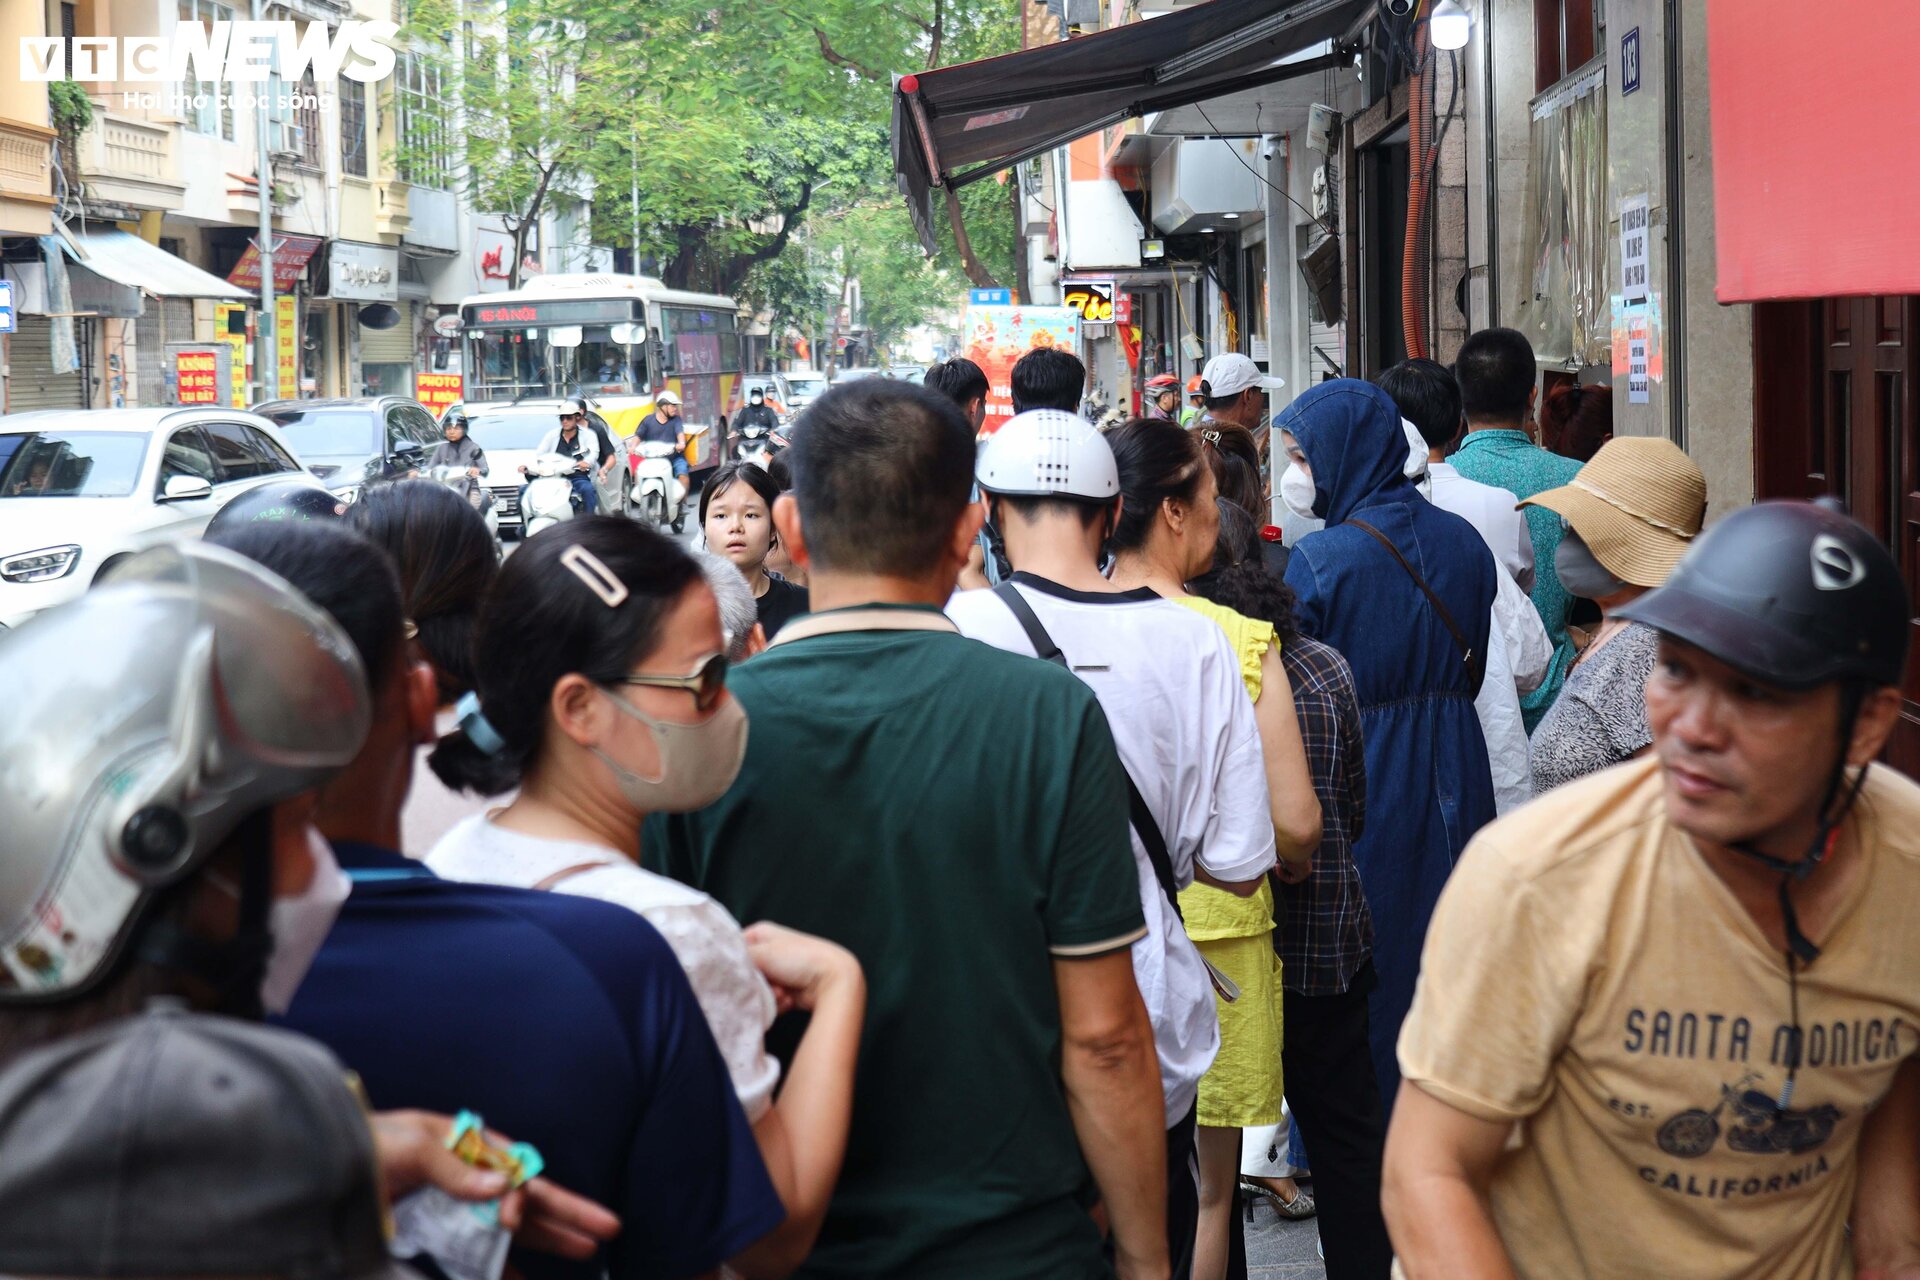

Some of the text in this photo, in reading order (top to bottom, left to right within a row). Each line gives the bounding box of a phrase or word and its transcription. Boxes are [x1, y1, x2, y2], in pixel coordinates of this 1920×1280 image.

[1623, 38, 1636, 87] 183
[178, 354, 214, 371] KHÔNG
[194, 374, 214, 386] RÁC
[418, 375, 461, 388] PHOTO
[195, 389, 214, 402] ĐÂY
[418, 390, 430, 402] IN
[1624, 1009, 1904, 1069] SANTA MONICA
[1608, 1098, 1654, 1119] EST.
[1638, 1155, 1828, 1198] CALIFORNIA
